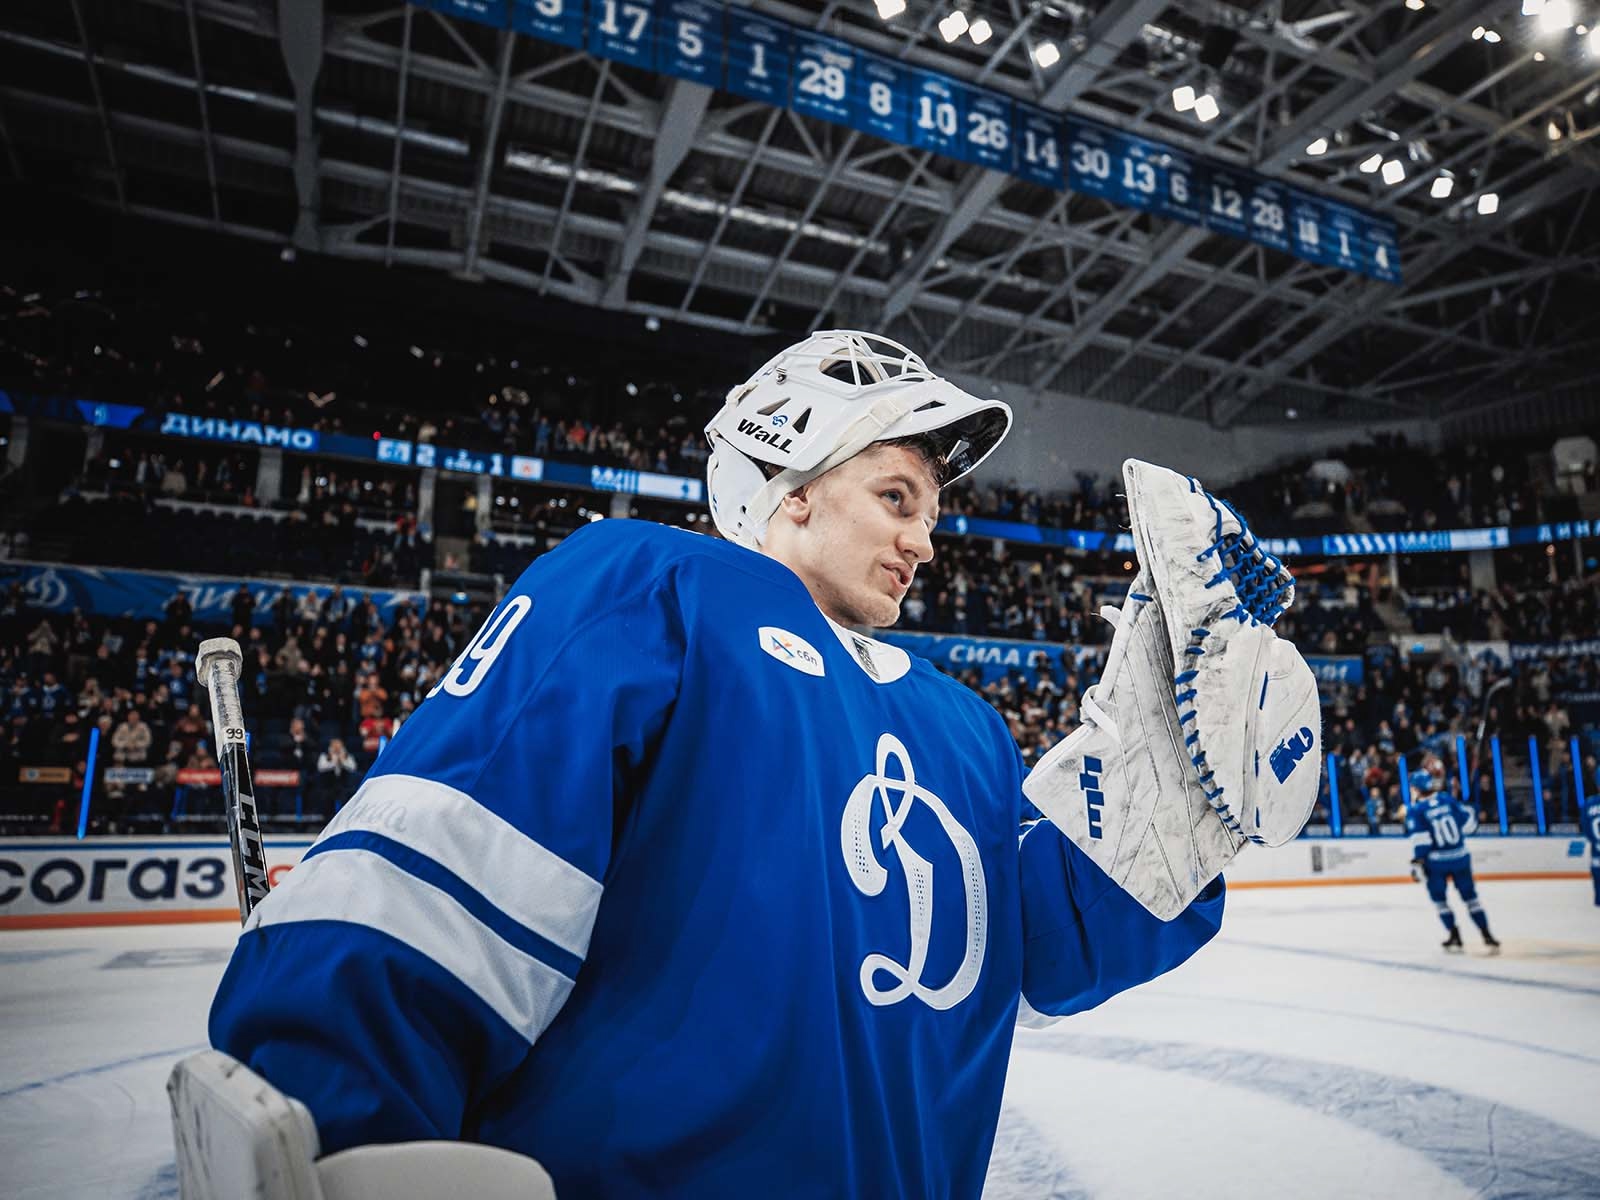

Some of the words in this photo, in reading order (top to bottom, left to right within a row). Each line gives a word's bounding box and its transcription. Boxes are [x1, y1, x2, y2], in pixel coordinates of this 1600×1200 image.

[599, 0, 648, 40] 17
[678, 21, 703, 57] 5
[750, 43, 768, 78] 1
[798, 60, 846, 100] 29
[869, 82, 892, 116] 8
[917, 96, 957, 136] 10
[967, 112, 1009, 150] 26
[1024, 131, 1059, 168] 14
[1071, 142, 1110, 179] 30
[1122, 157, 1156, 193] 13
[1170, 173, 1189, 202] 6
[1211, 184, 1243, 219] 12
[1251, 198, 1285, 231] 28
[160, 412, 313, 449] ДИНАМО
[426, 595, 532, 698] 9
[950, 644, 1020, 666] СИЛА
[226, 728, 244, 739] 99
[1431, 815, 1461, 848] 10
